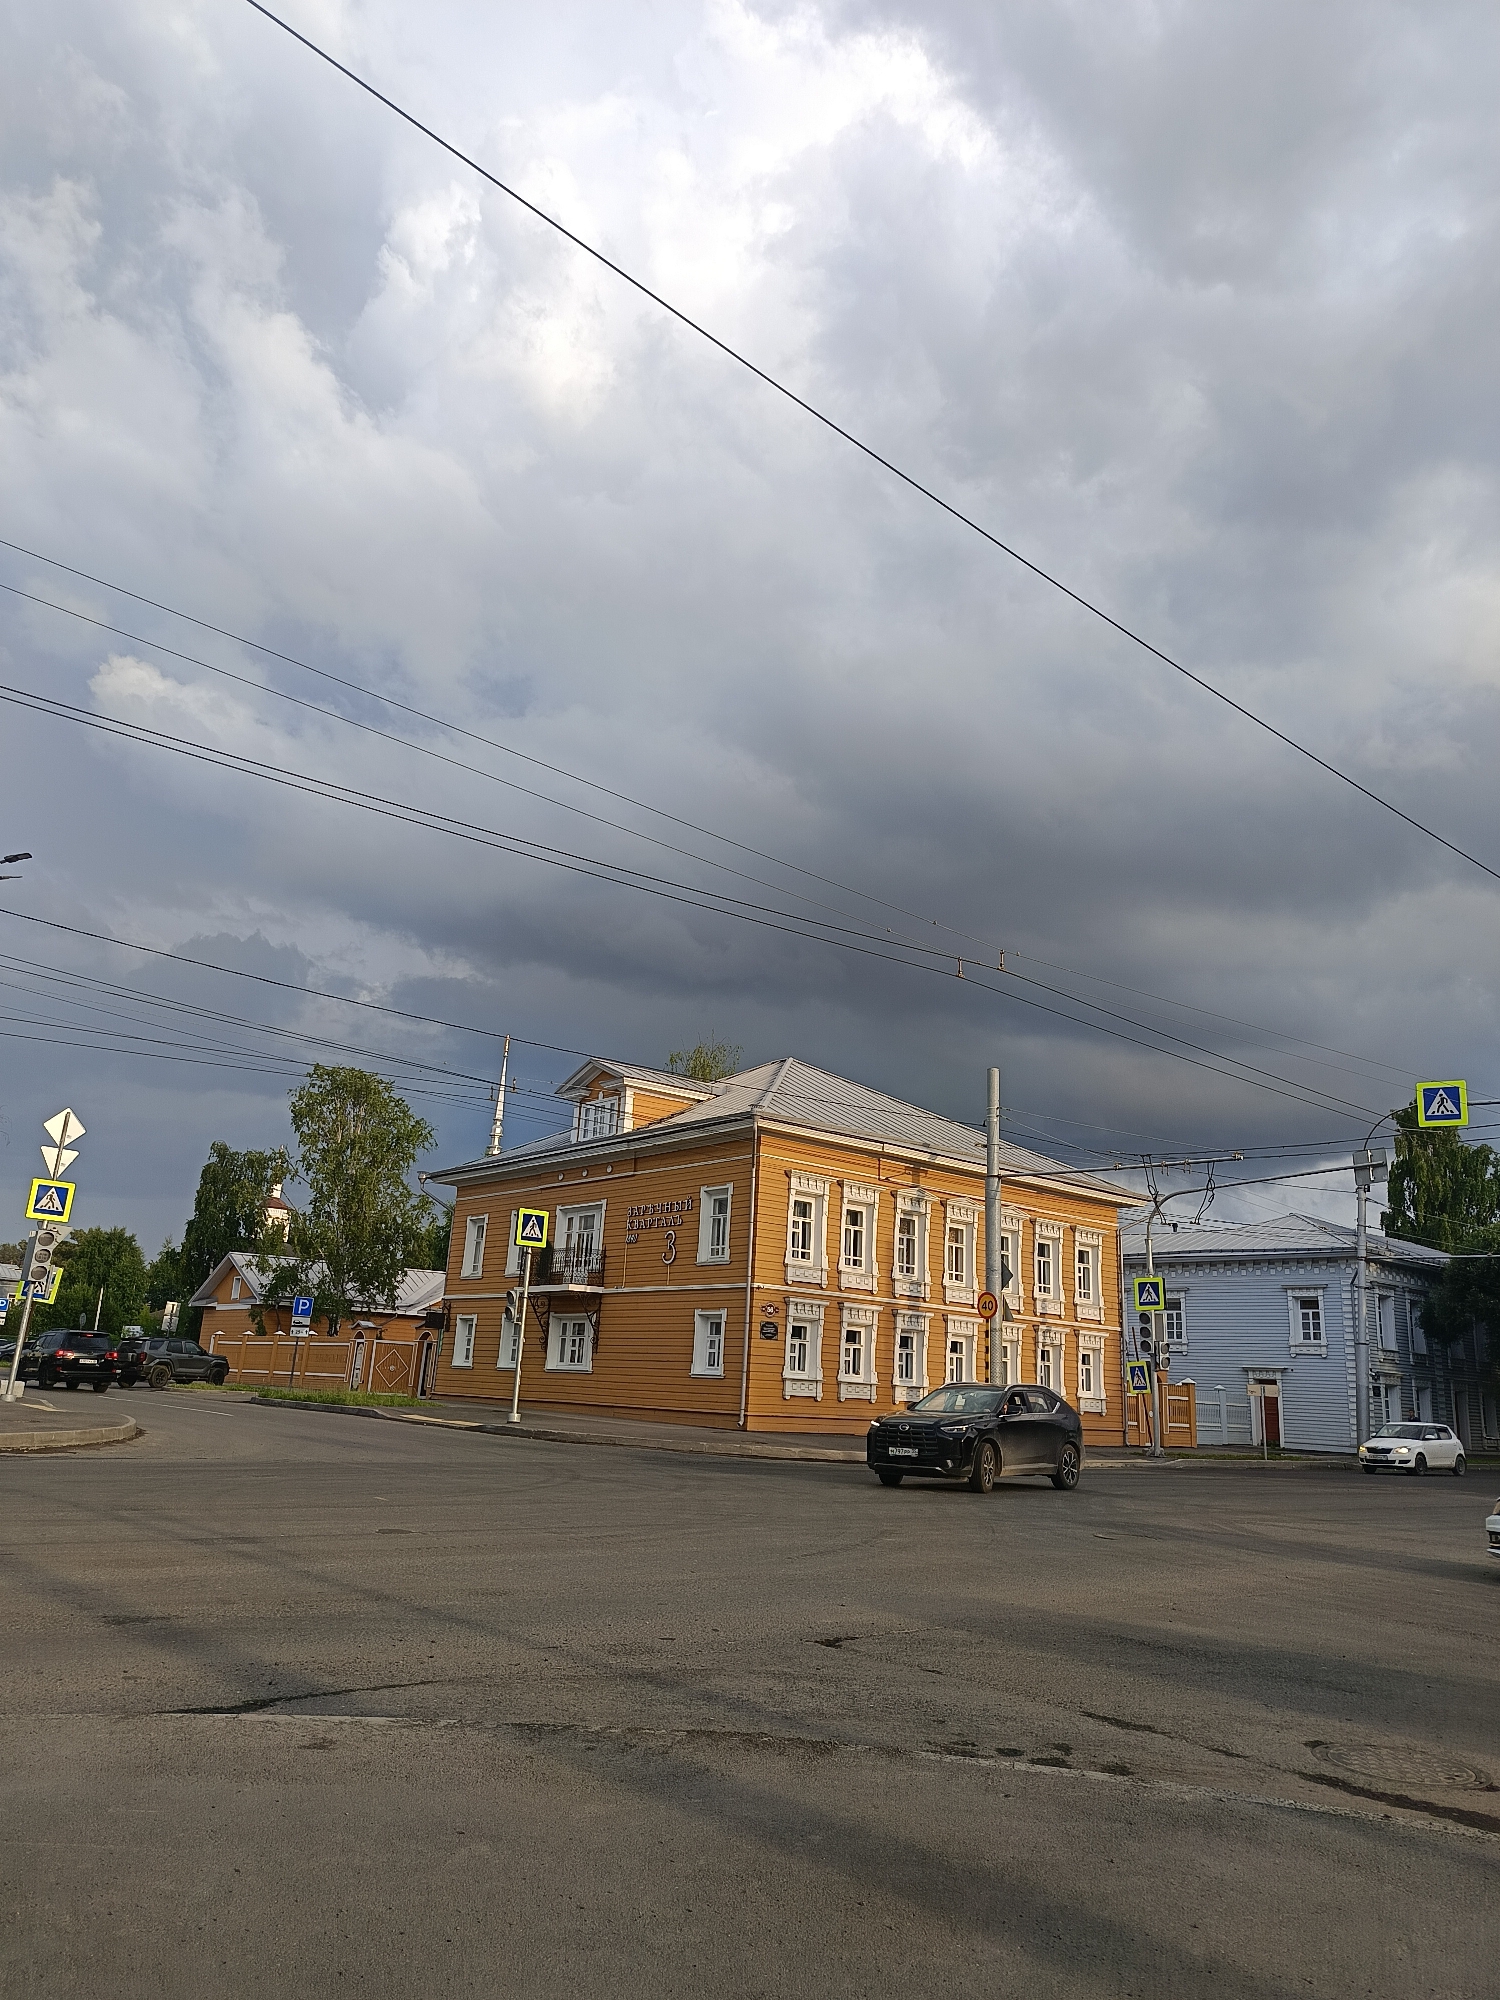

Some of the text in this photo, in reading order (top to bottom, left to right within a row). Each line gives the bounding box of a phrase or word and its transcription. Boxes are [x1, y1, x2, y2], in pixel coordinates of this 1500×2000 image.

[626, 1215, 683, 1230] КВАРТАЛЪ
[662, 1230, 676, 1265] 3
[298, 1299, 310, 1314] P
[981, 1300, 994, 1311] 40
